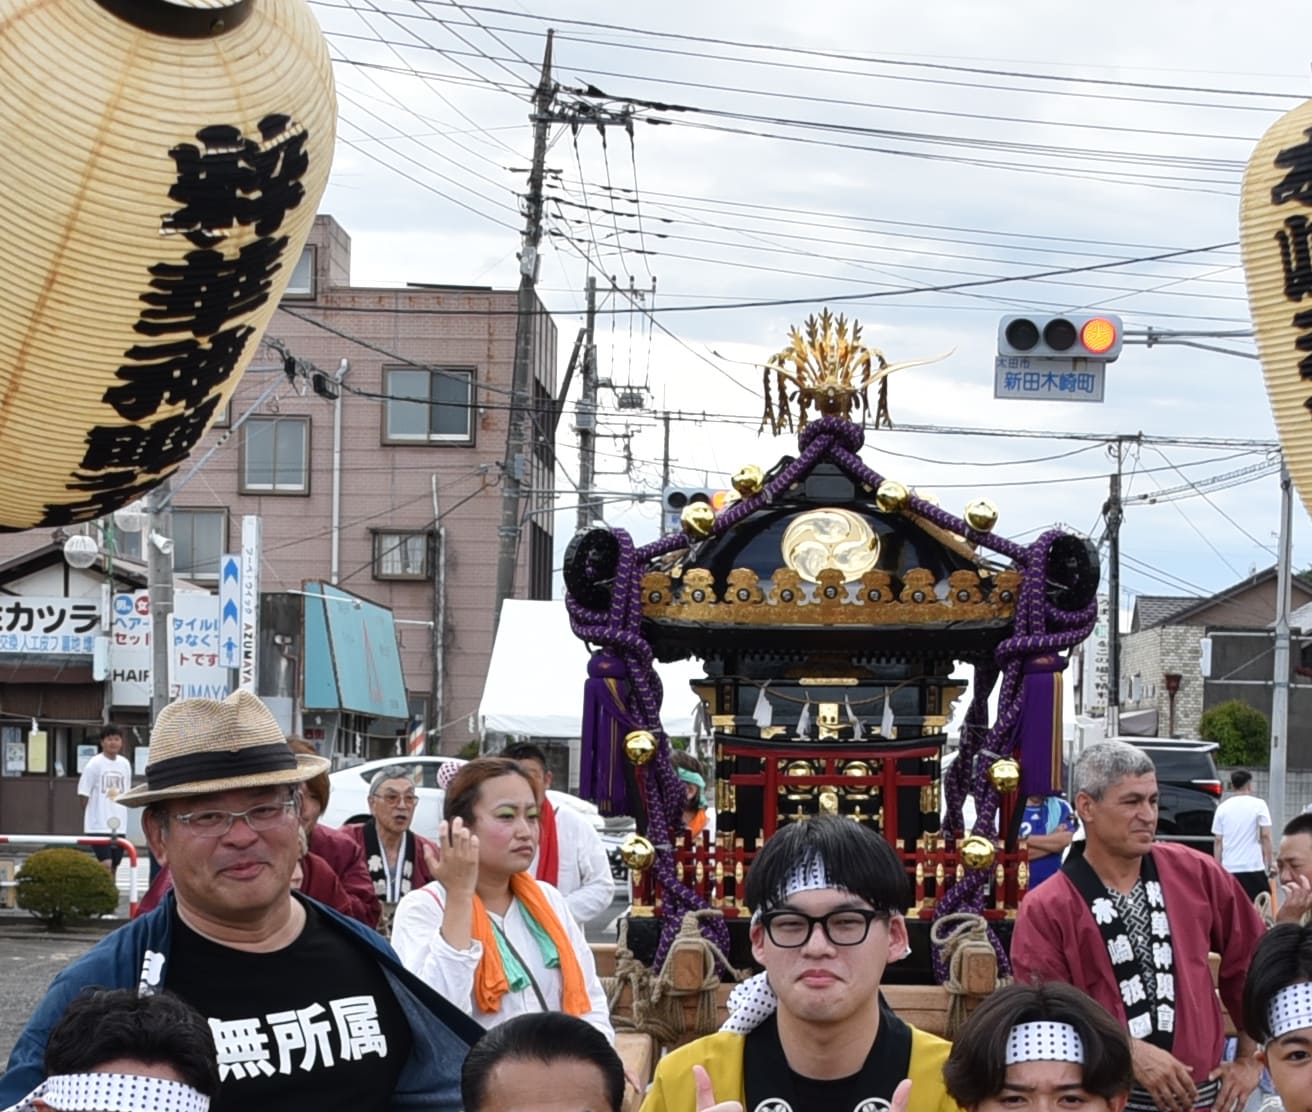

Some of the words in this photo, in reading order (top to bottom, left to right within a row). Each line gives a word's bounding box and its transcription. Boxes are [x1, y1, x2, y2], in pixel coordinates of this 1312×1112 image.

[1004, 371, 1095, 393] 新田木崎町
[208, 995, 387, 1082] 無所属
